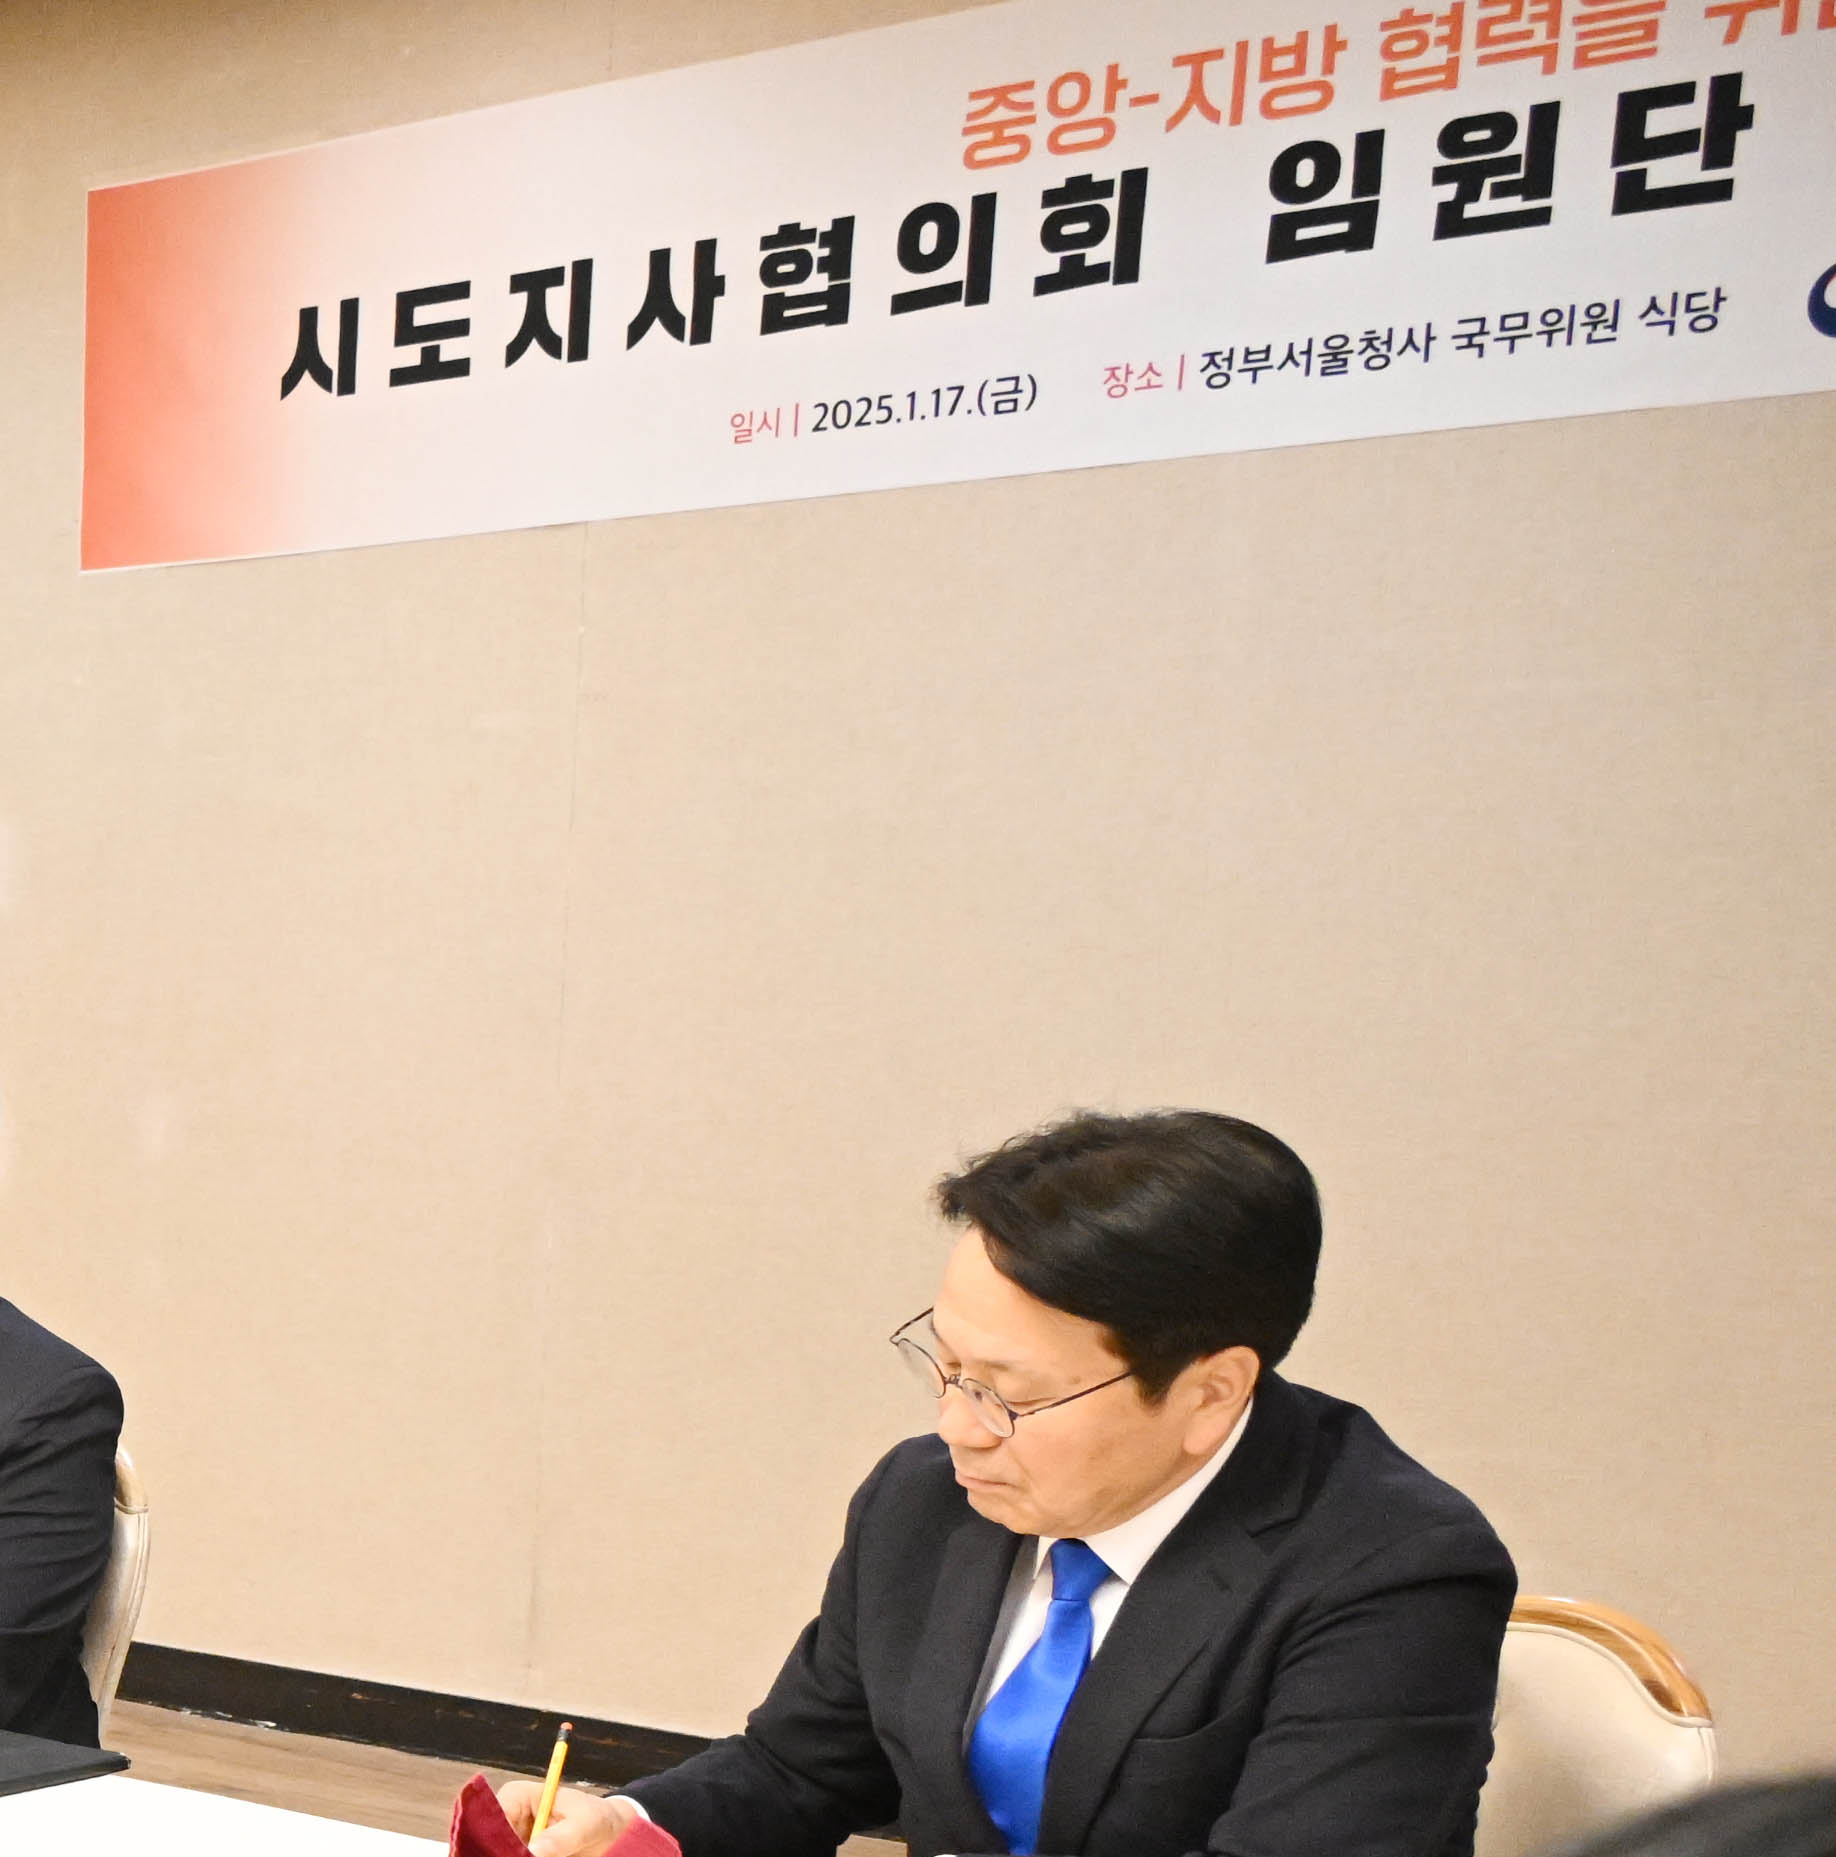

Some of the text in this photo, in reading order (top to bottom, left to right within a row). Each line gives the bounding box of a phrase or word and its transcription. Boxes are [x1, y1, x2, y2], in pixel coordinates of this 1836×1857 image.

[961, 24, 1348, 170] 중앙-지방
[280, 72, 1755, 401] 시도지사협의회 임원단
[1103, 286, 1728, 399] 장소 정부서울청사 국무위원 식당
[729, 374, 1038, 444] 일시 2025.1.17.(금)
